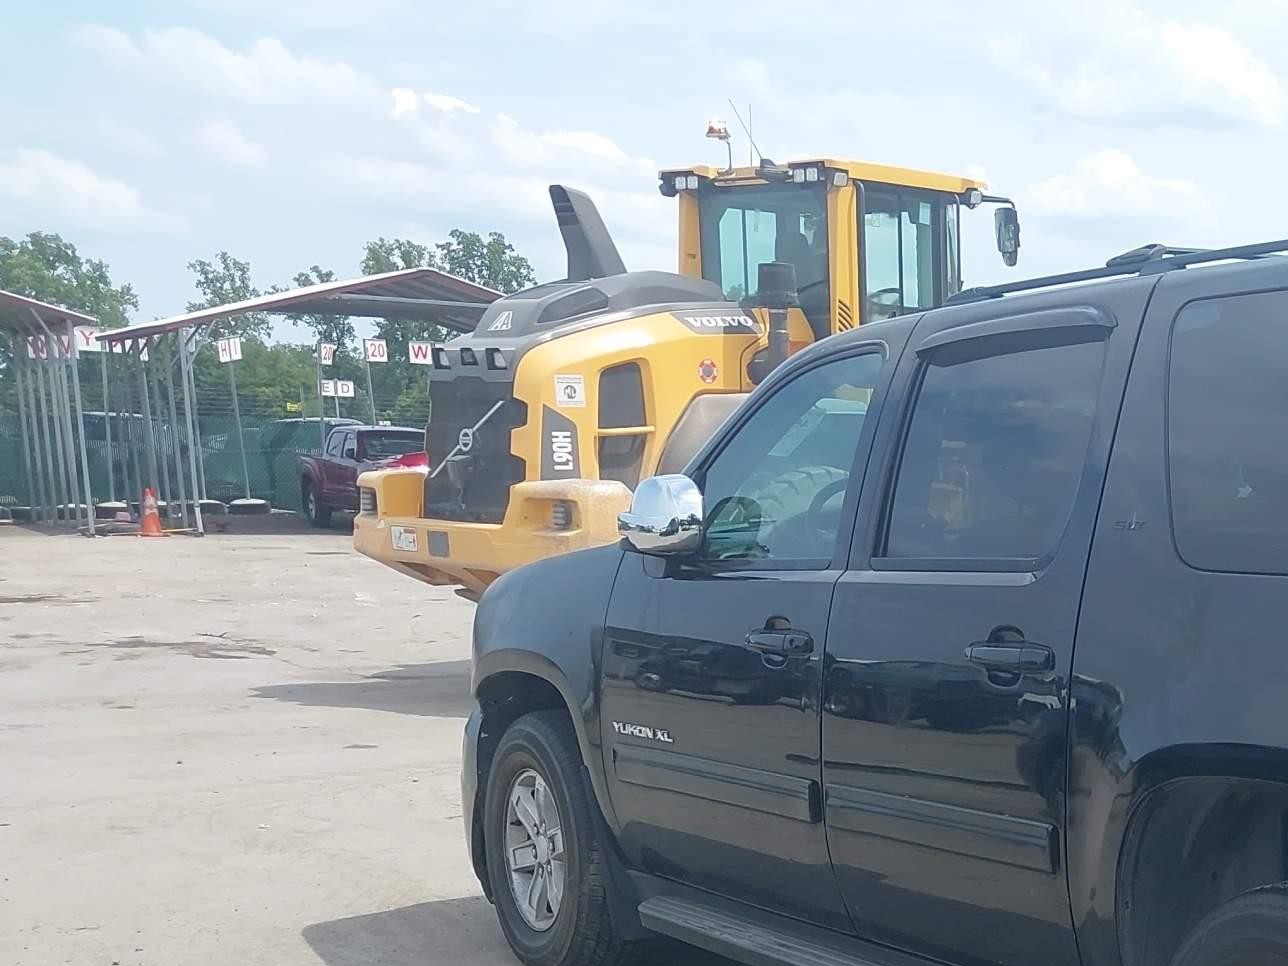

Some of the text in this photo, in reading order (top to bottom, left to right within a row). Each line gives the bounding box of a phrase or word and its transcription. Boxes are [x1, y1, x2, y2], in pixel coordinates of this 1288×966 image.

[684, 316, 753, 327] VOLVO
[79, 330, 95, 346] Y
[322, 346, 333, 361] 20
[369, 343, 385, 358] 20
[412, 345, 429, 360] W
[551, 431, 574, 471] L90H
[612, 721, 673, 743] YUKON XL
